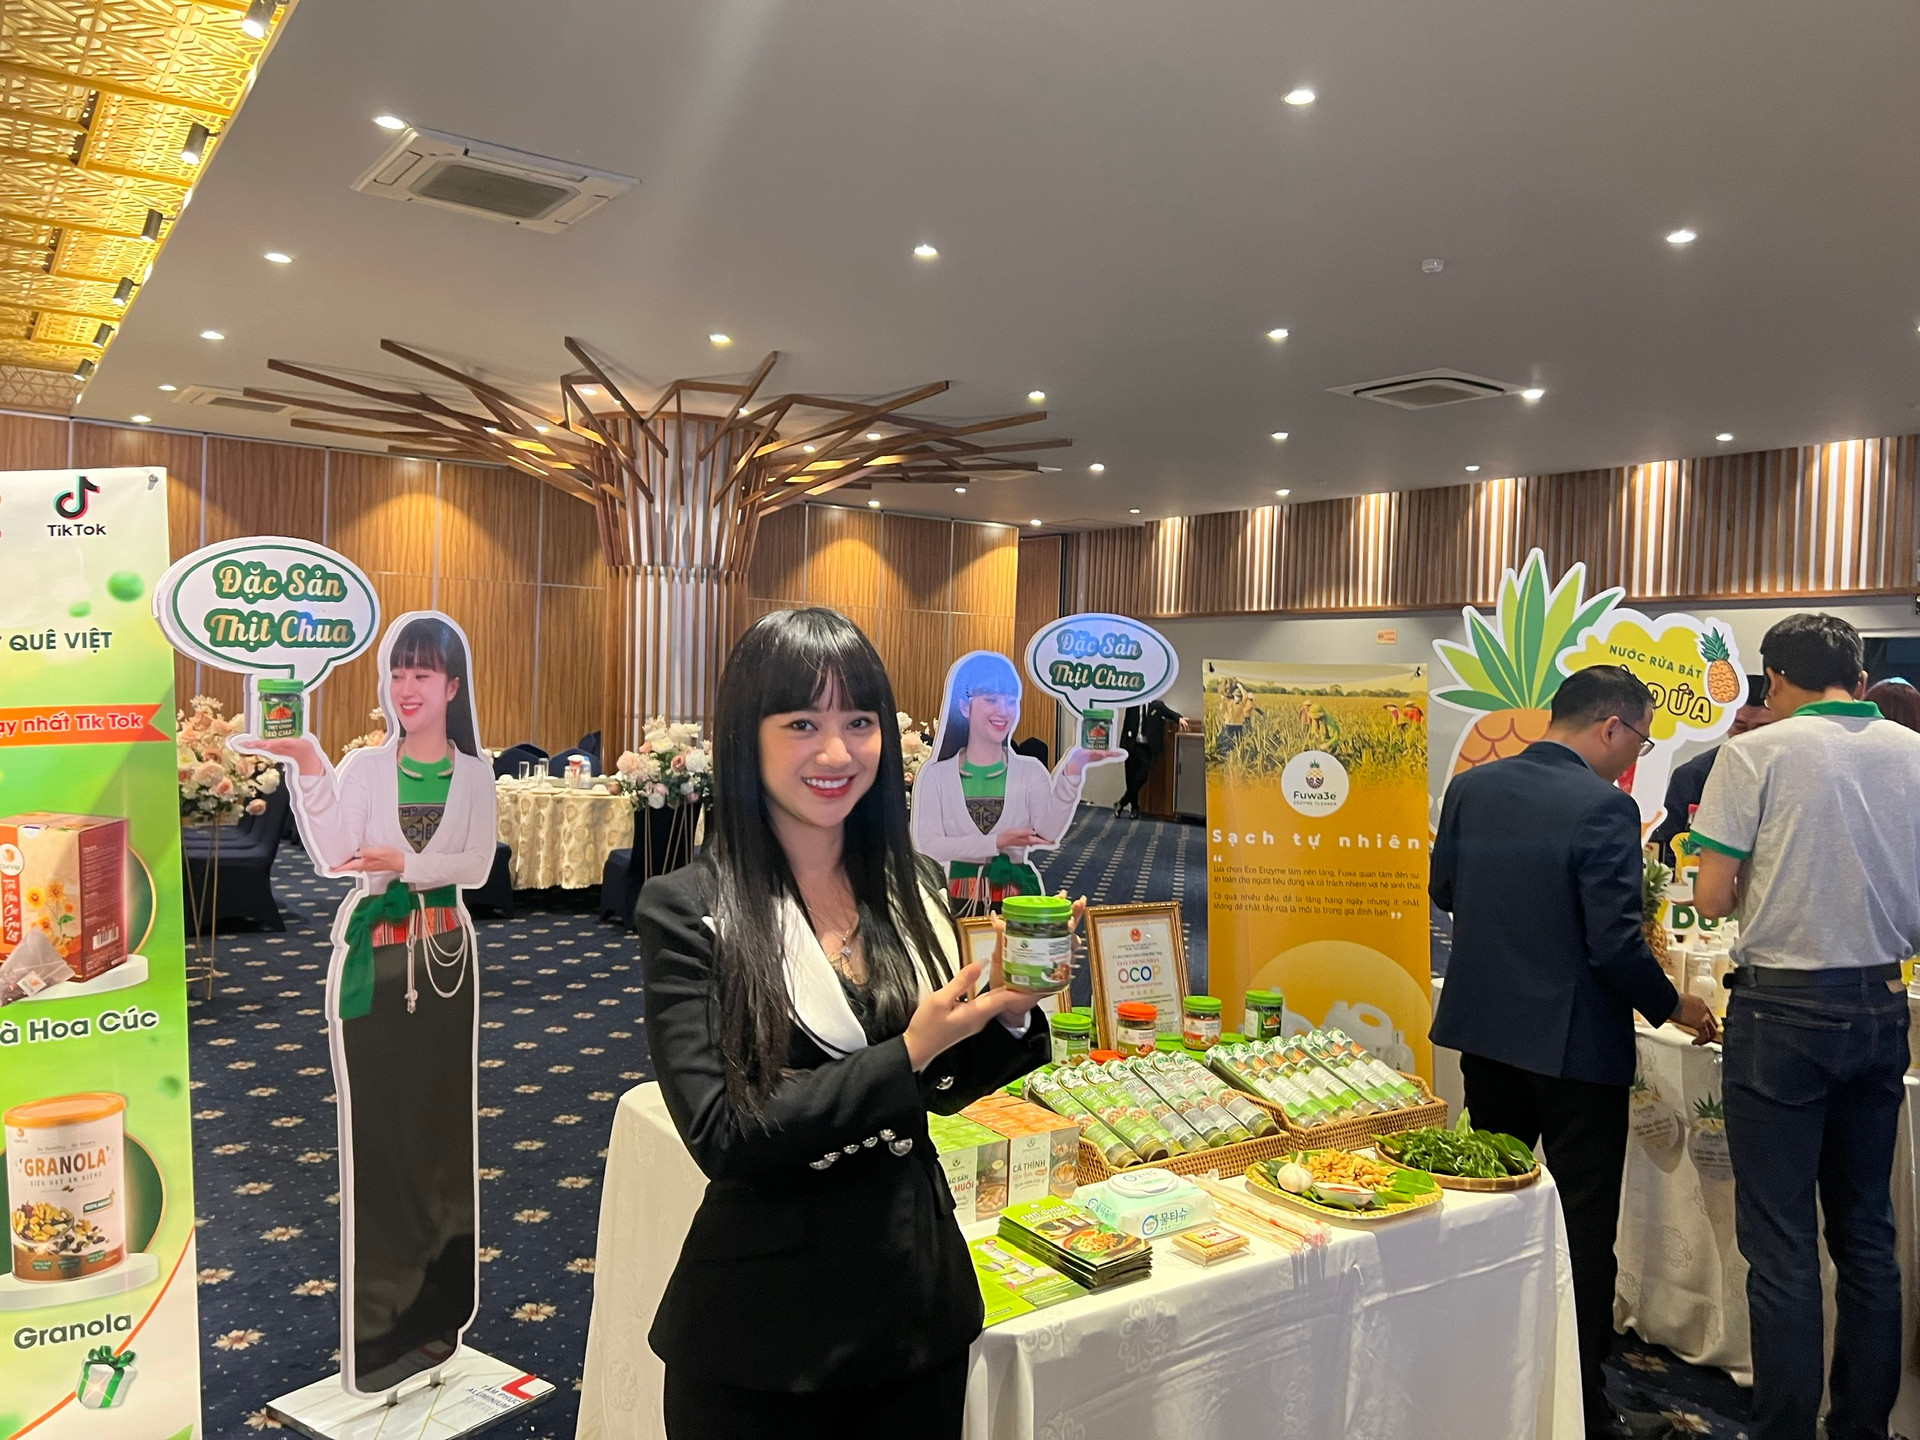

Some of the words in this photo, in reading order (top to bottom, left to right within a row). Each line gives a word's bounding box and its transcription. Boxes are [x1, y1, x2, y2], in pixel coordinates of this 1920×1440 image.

[47, 523, 107, 537] TikTok
[218, 565, 277, 598] Đặc
[288, 569, 342, 598] Sản
[9, 628, 57, 651] QUÊ
[64, 627, 113, 653] VIỆT
[210, 613, 271, 647] Thịt
[281, 616, 350, 643] Chua
[1102, 633, 1139, 657] Sản
[1609, 644, 1646, 663] NƯỚC
[1650, 655, 1674, 672] RỬA
[1678, 663, 1703, 679] BÁT
[1053, 663, 1089, 687] Thịt
[1095, 667, 1140, 688] Chua
[1646, 682, 1711, 723] DỨA
[24, 711, 70, 732] nhất
[76, 714, 103, 730] Tik
[108, 713, 142, 728] Tok
[1293, 790, 1337, 800] Fuwa3e
[1212, 828, 1274, 847] Sạch
[1292, 832, 1321, 849] tự
[1339, 833, 1420, 849] nhiên
[1118, 965, 1161, 983] OCOP
[29, 1018, 90, 1040] Hoa
[98, 1007, 158, 1032] Cúc
[13, 1313, 132, 1349] Granola
